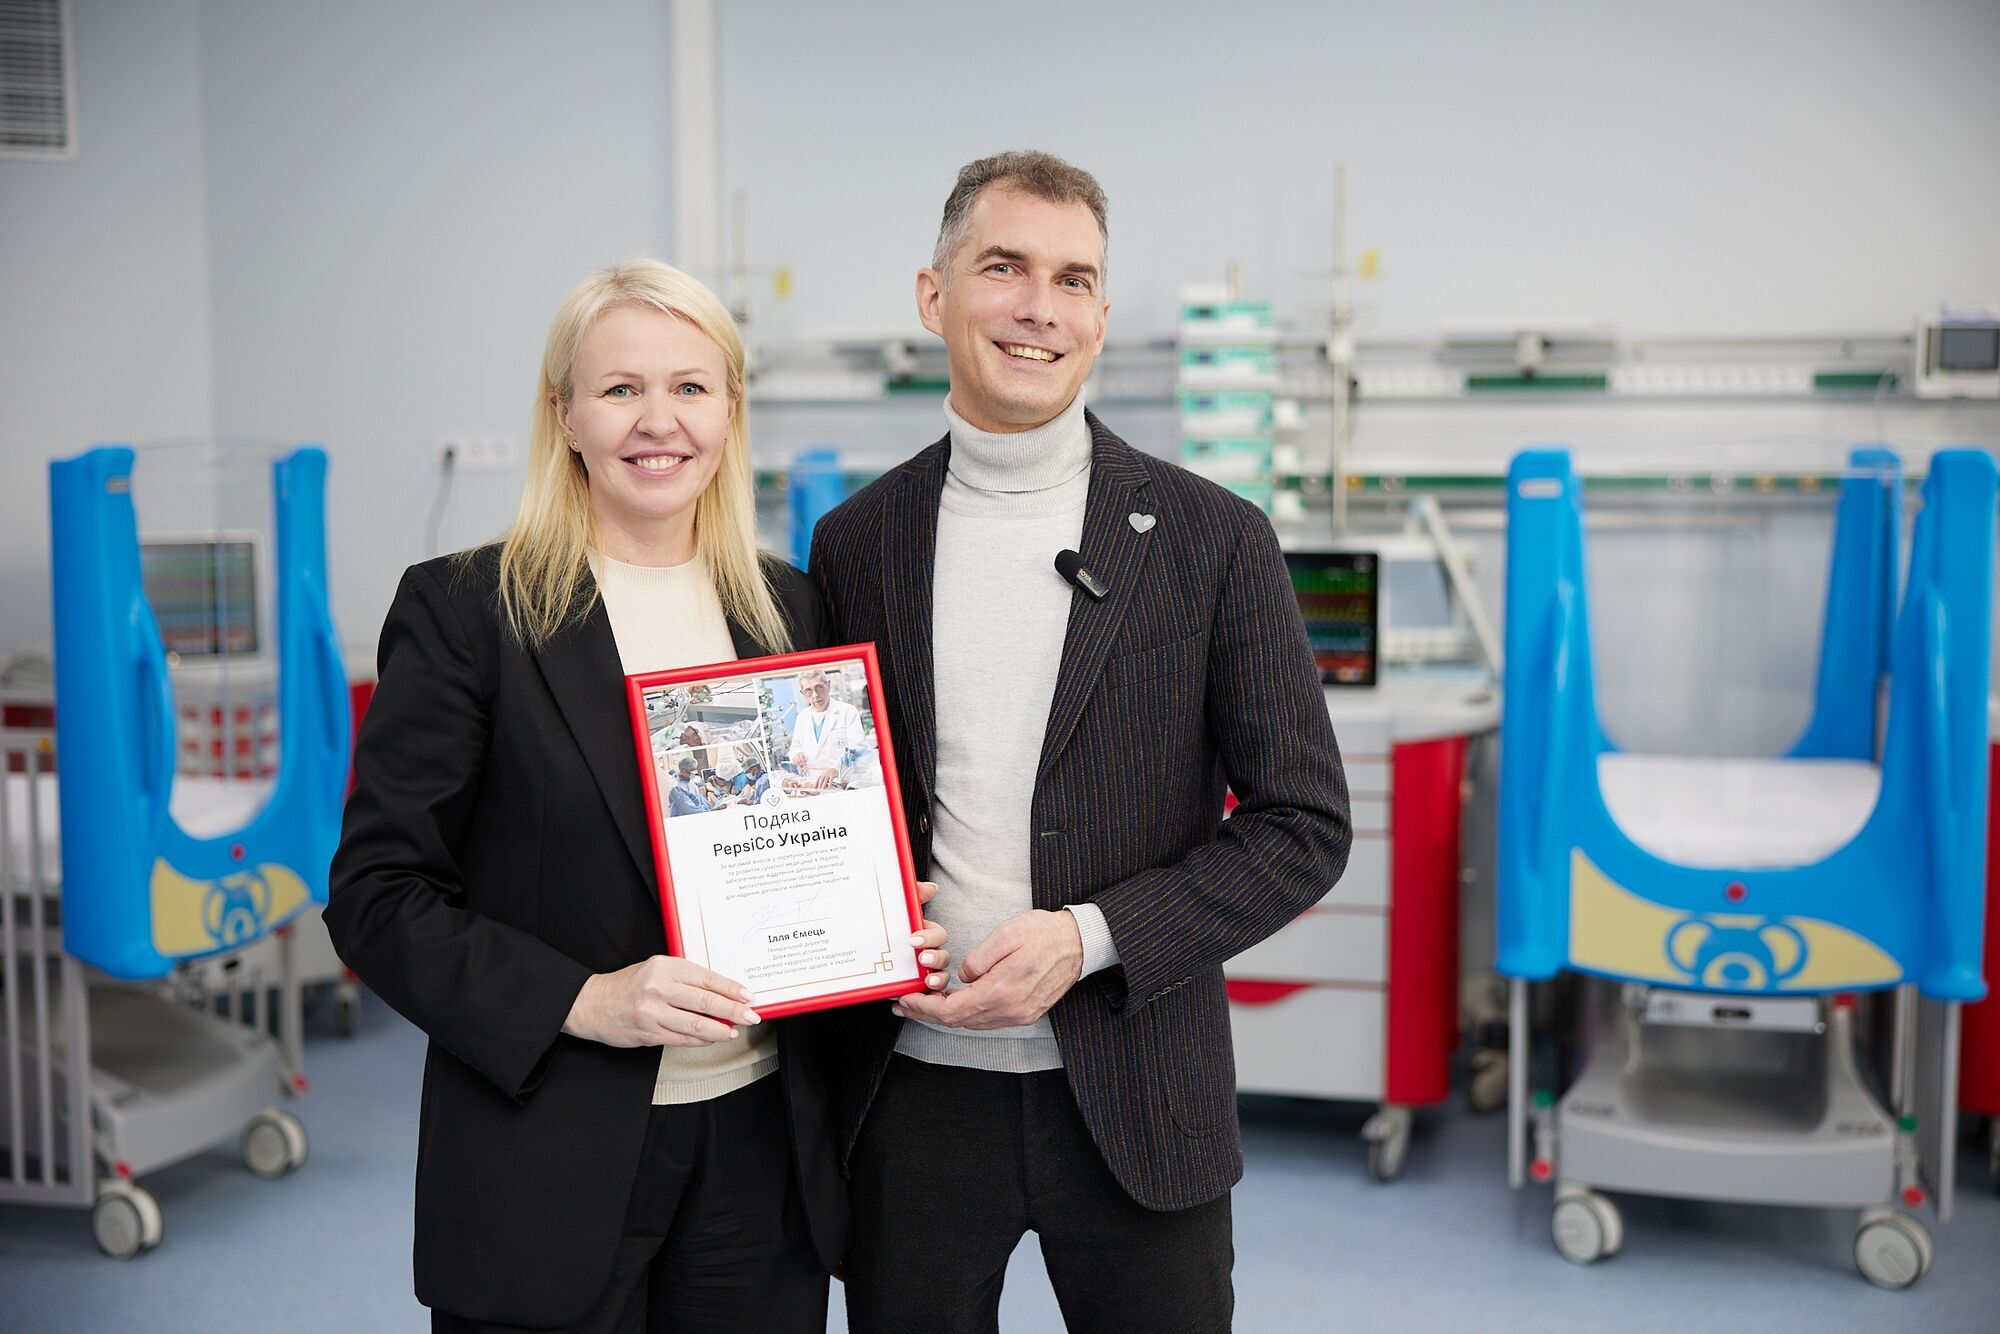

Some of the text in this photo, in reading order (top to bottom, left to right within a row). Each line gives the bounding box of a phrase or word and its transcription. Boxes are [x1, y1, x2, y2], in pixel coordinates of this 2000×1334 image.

[744, 810, 811, 830] Подяка
[713, 826, 847, 857] PepsiCo Україна
[768, 928, 826, 943] Ілля Ємець
